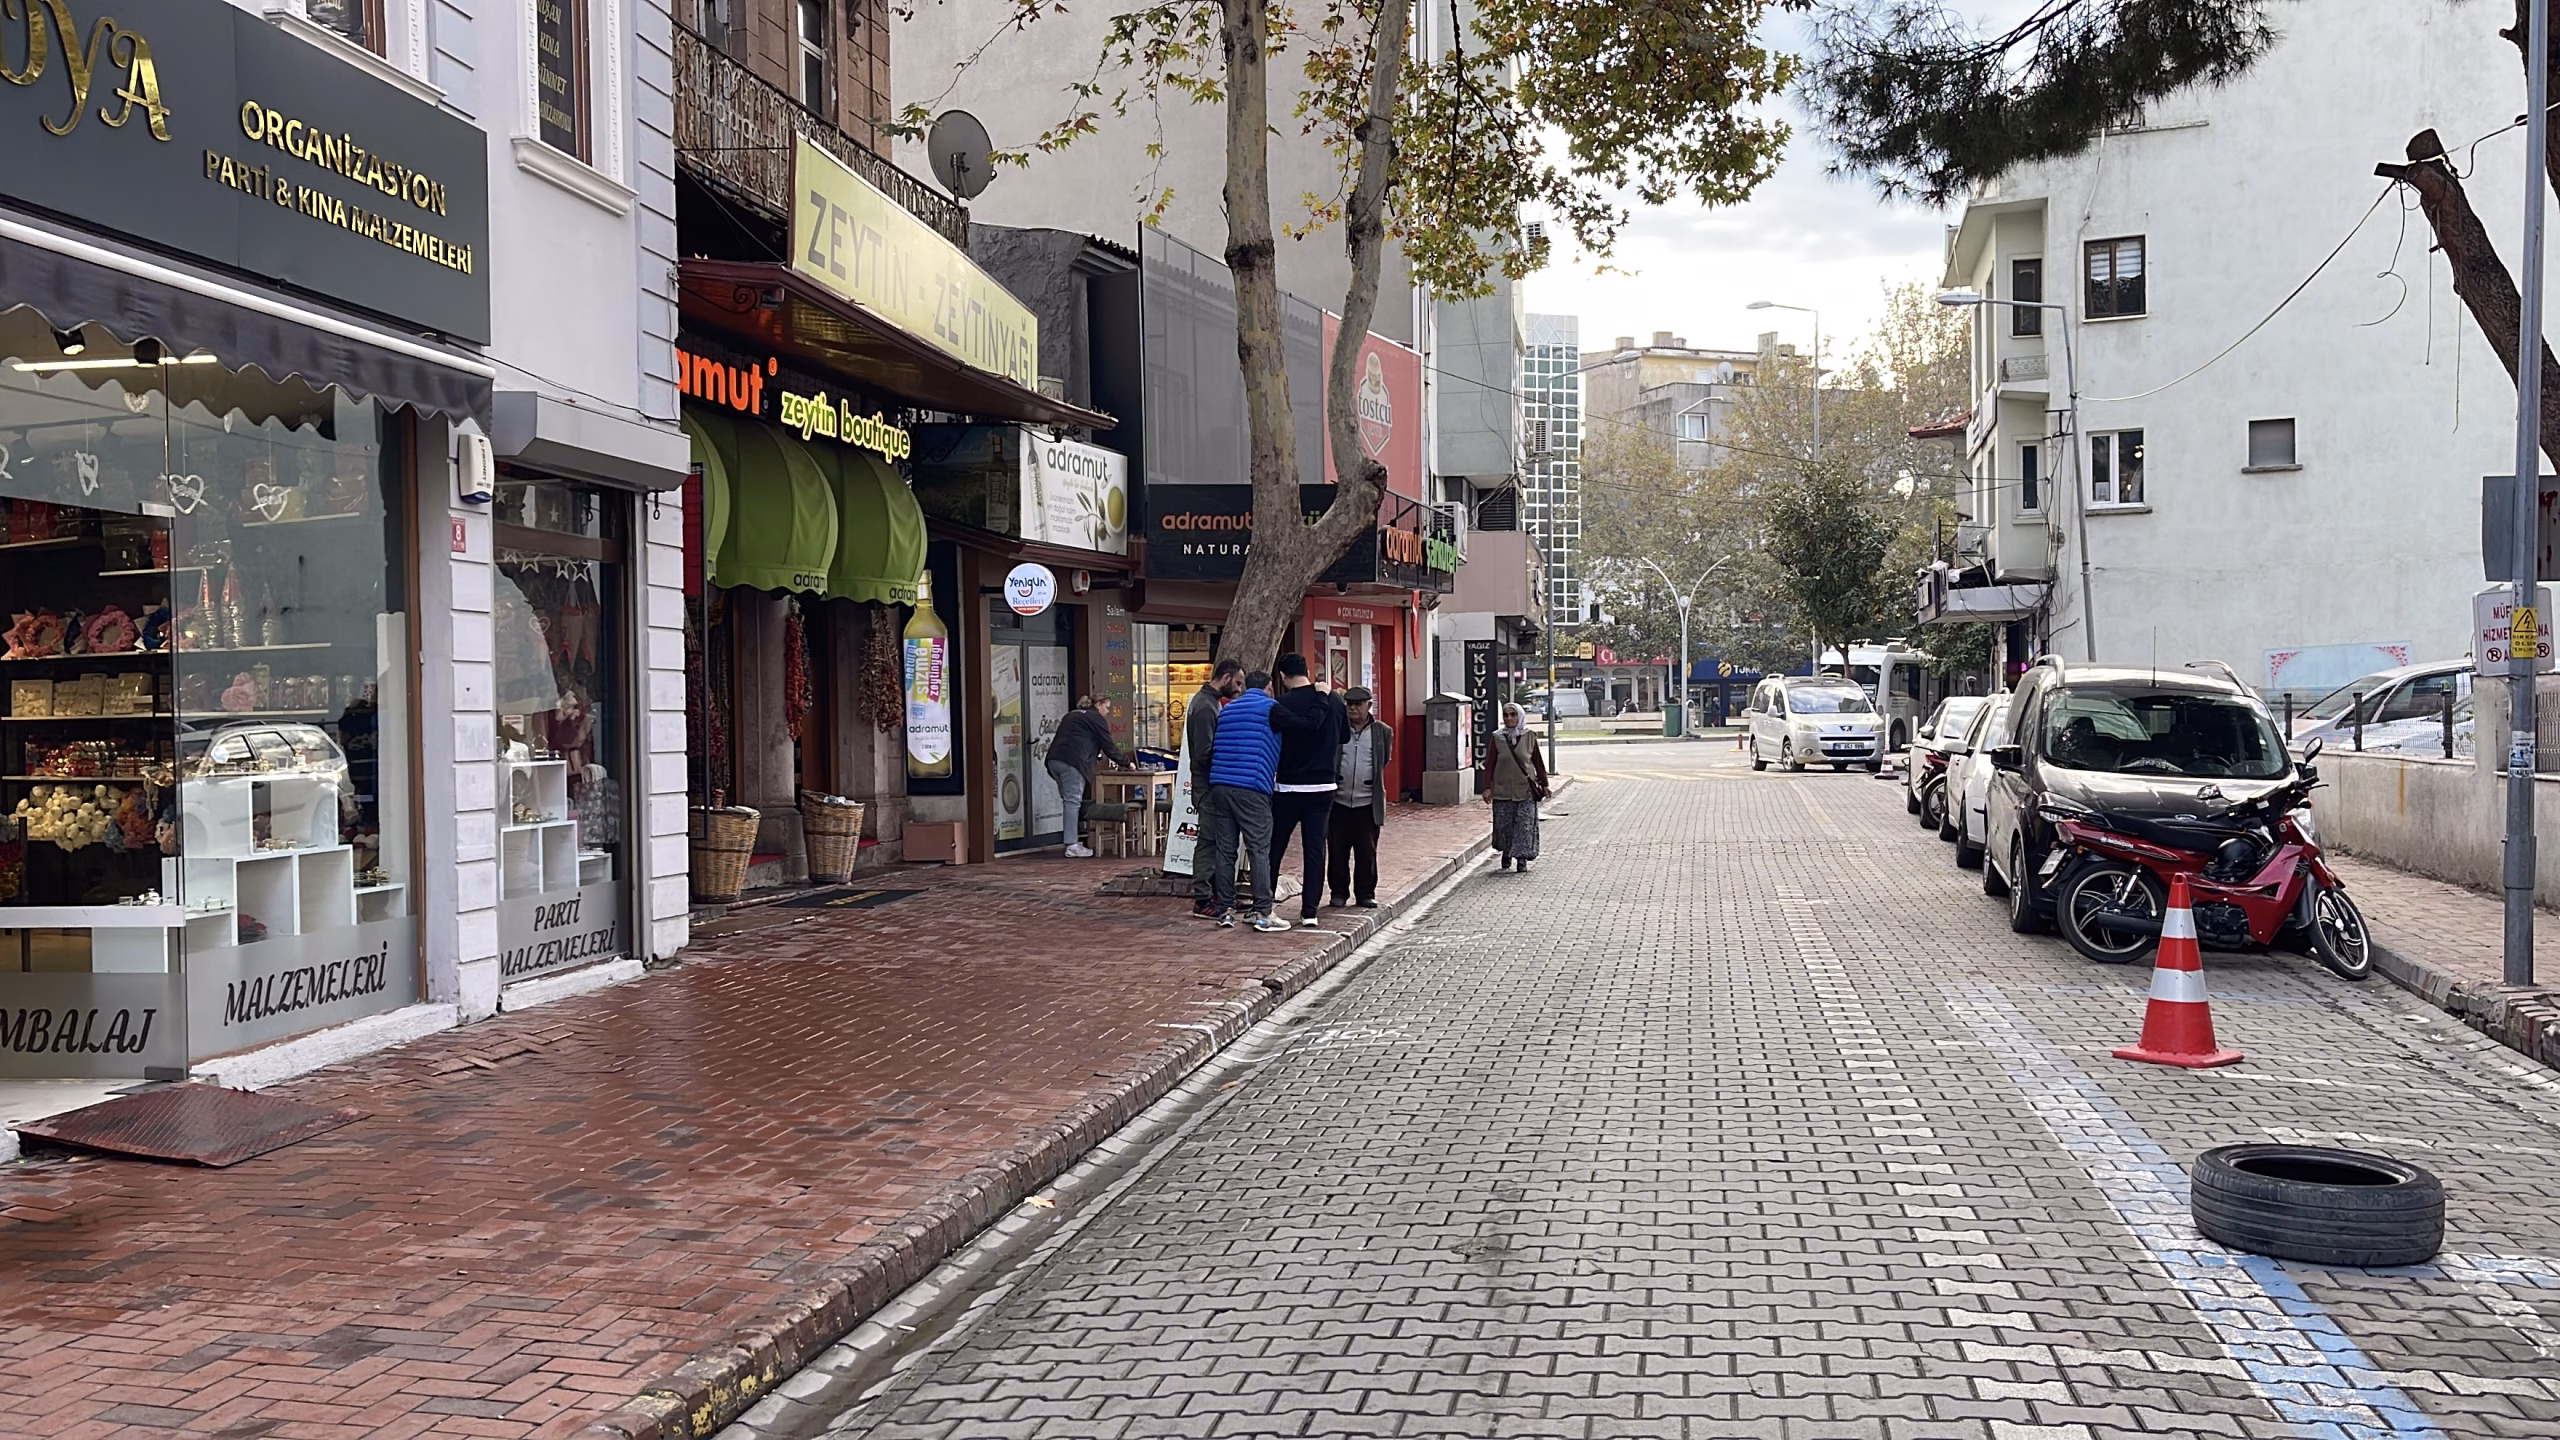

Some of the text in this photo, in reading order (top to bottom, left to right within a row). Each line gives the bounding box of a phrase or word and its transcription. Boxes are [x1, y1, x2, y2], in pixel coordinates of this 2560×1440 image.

[540, 31, 560, 58] KINA
[241, 100, 447, 216] ORGANİZASYON
[205, 149, 473, 275] PARTİ & KINA MALZEMELERİ
[807, 189, 909, 317] ZEYTİN
[933, 272, 1035, 391] ZEYTİNYAĞI
[781, 391, 911, 464] zeytin boutique
[1047, 445, 1108, 483] adramut
[456, 525, 461, 540] 8
[1162, 512, 1253, 530] adramut
[1012, 597, 1044, 606] Reçelleri
[1106, 604, 1125, 616] Salam
[2493, 603, 2512, 619] MÜF
[905, 644, 916, 680] naturel
[1032, 673, 1066, 687] adramut
[909, 724, 949, 733] adramut
[1472, 653, 1489, 770] KUYUMCULUK
[534, 892, 582, 933] PARTİ
[224, 940, 388, 1027] MALZEMELERİ
